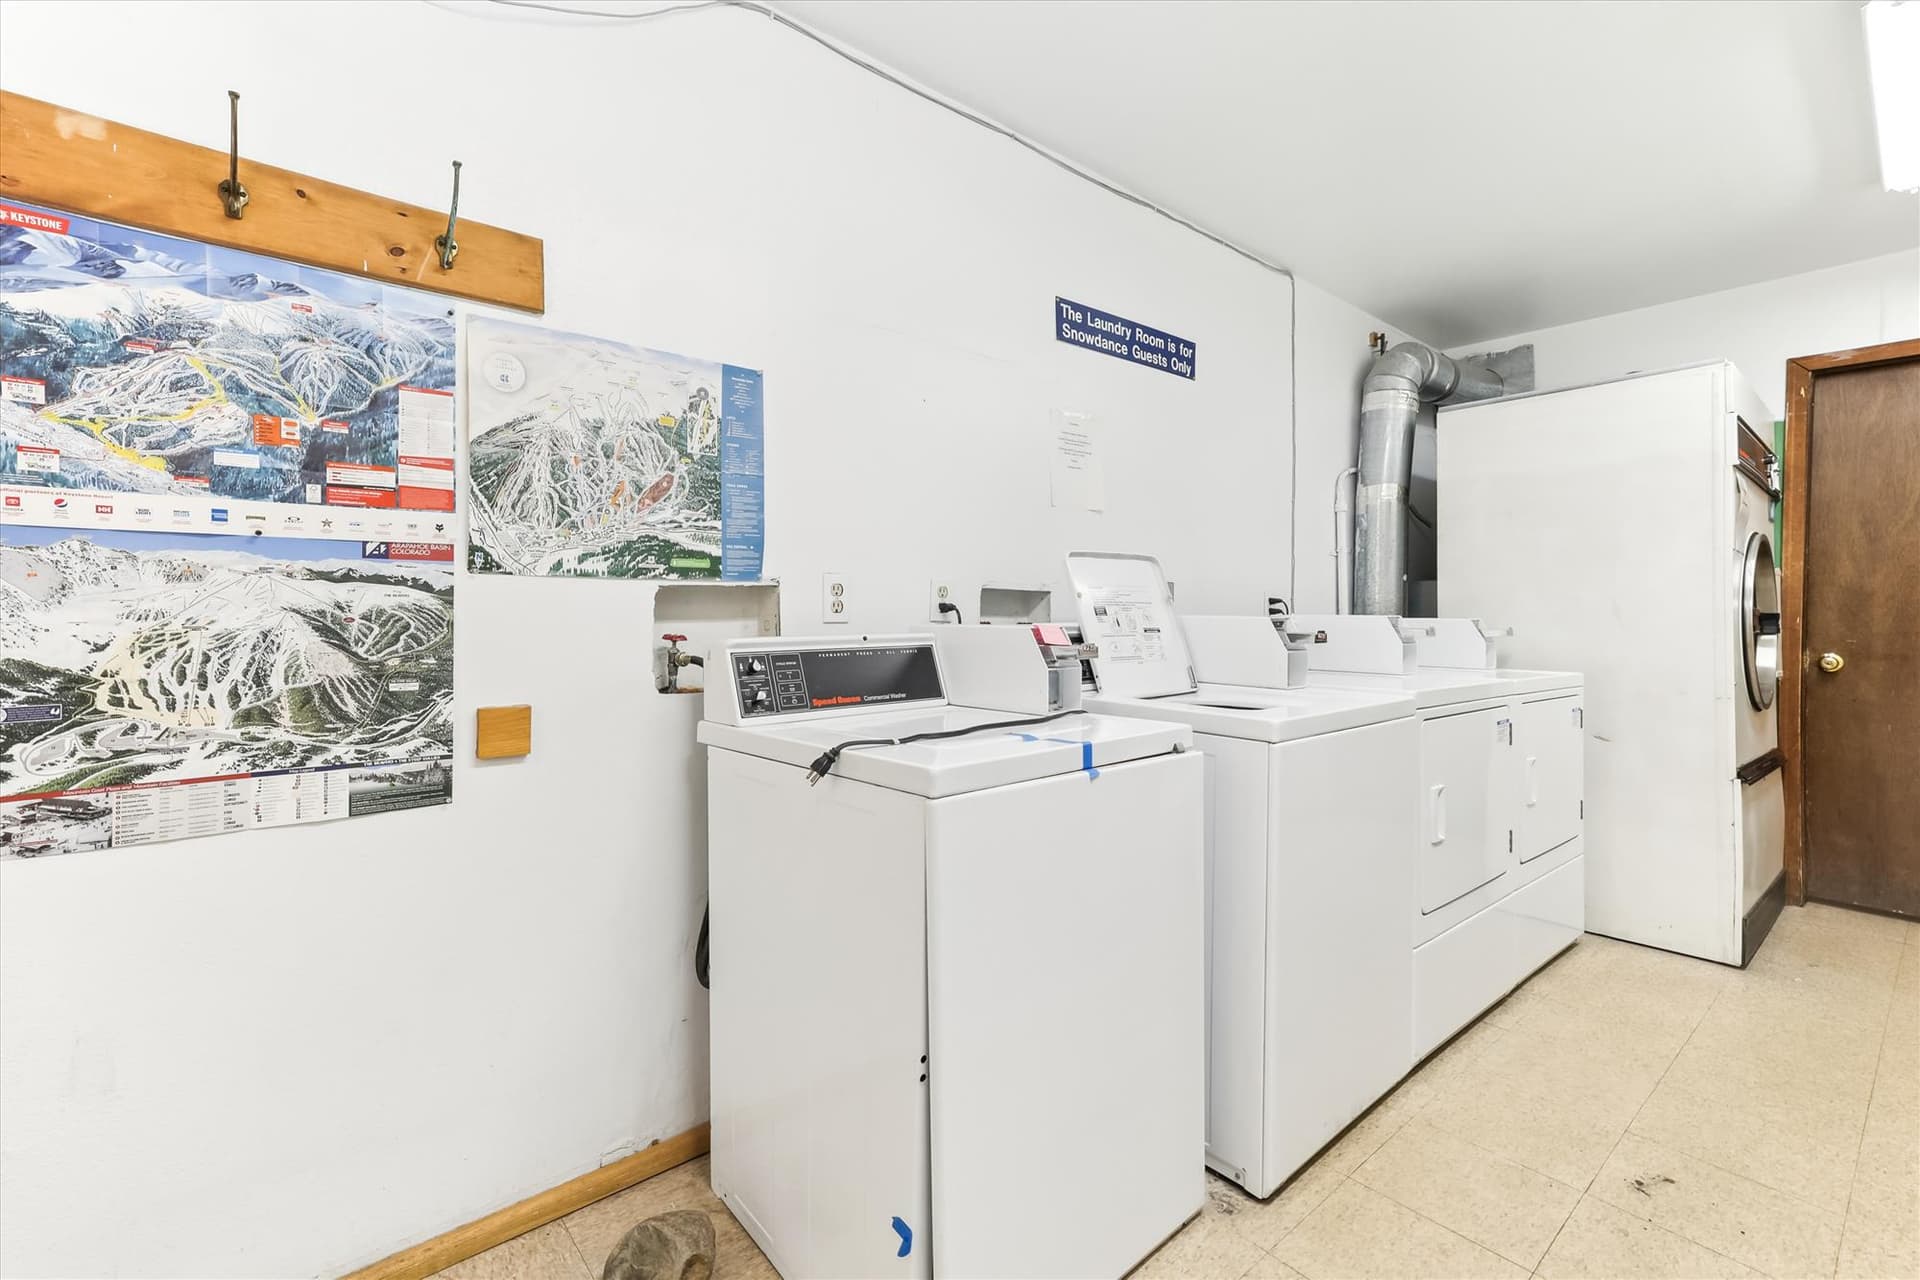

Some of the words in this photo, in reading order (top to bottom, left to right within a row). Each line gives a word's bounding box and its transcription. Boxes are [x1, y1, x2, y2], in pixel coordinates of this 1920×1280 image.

[10, 211, 63, 231] KEYSTONE
[1060, 303, 1083, 323] The
[1087, 312, 1132, 340] Laundry
[1136, 327, 1165, 350] Room
[1167, 338, 1177, 353] is
[1179, 343, 1193, 359] for
[1062, 323, 1128, 356] Snowdance
[1132, 345, 1168, 368] Guests
[1171, 357, 1192, 377] Only
[391, 548, 431, 556] COLORADO
